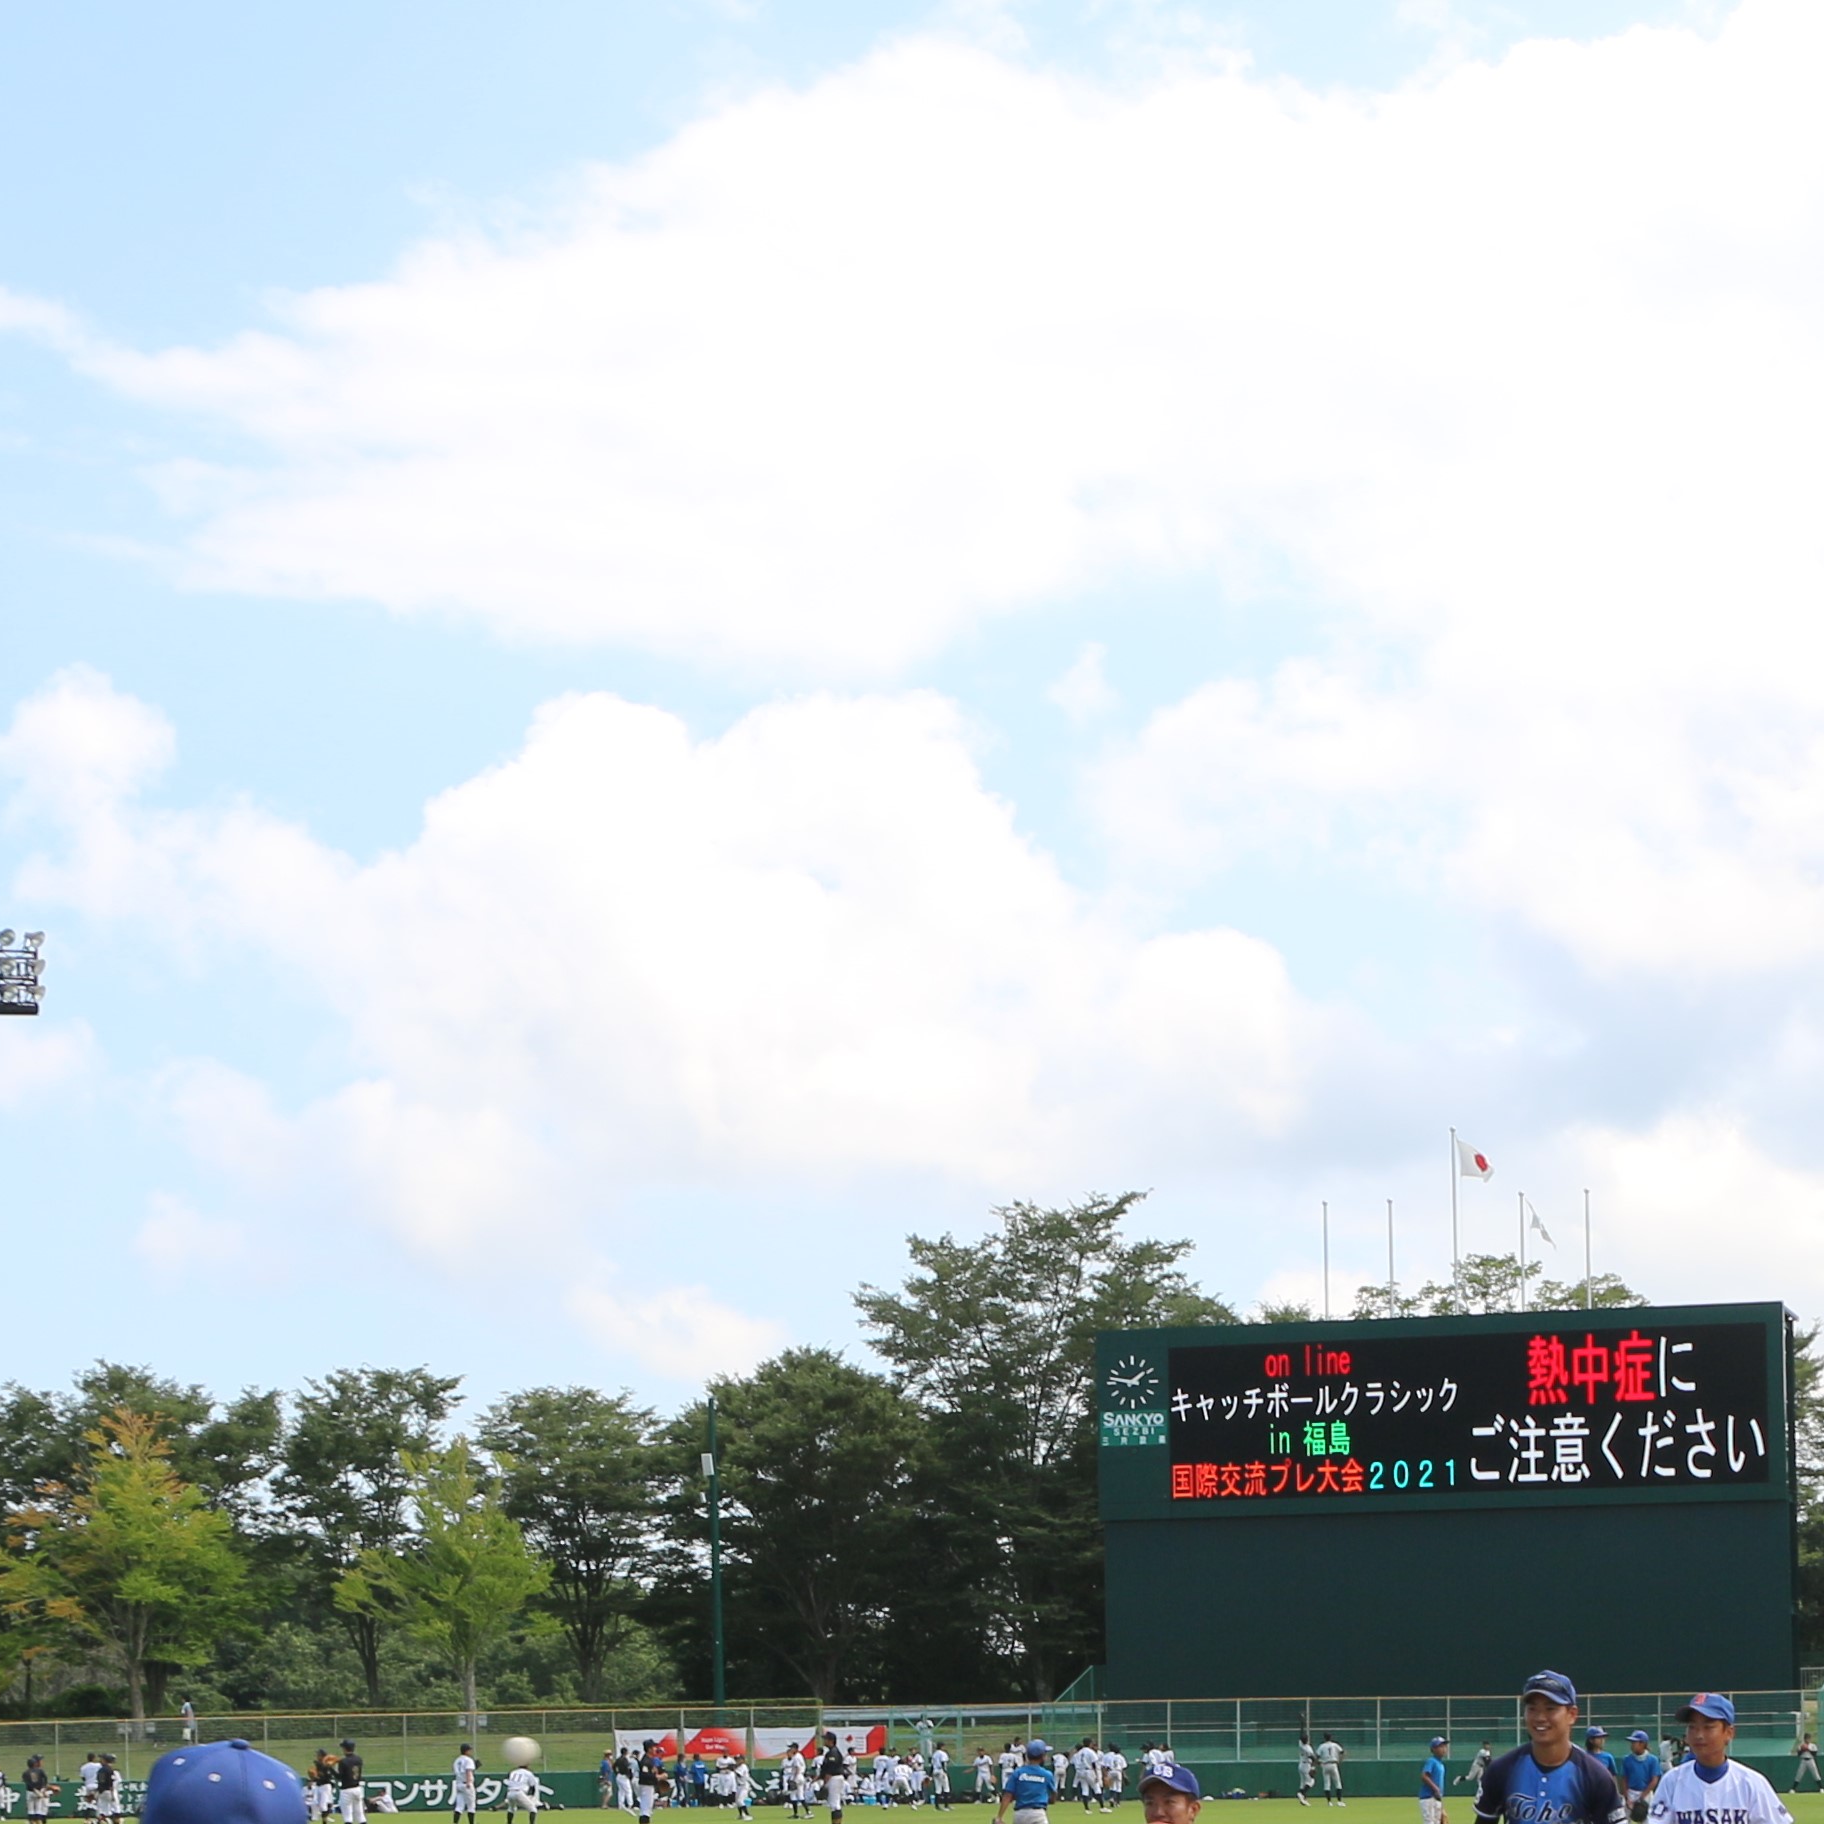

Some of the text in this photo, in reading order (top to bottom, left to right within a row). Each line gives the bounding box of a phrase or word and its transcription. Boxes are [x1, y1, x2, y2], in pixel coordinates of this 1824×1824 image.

[1265, 1344, 1351, 1377] on line
[1528, 1329, 1696, 1406] 熱中症に
[1102, 1411, 1165, 1427] SANKYO
[1170, 1377, 1459, 1422] キャッチボールクラシック
[1270, 1419, 1351, 1456] in 福島
[1469, 1408, 1766, 1483] ご注意ください
